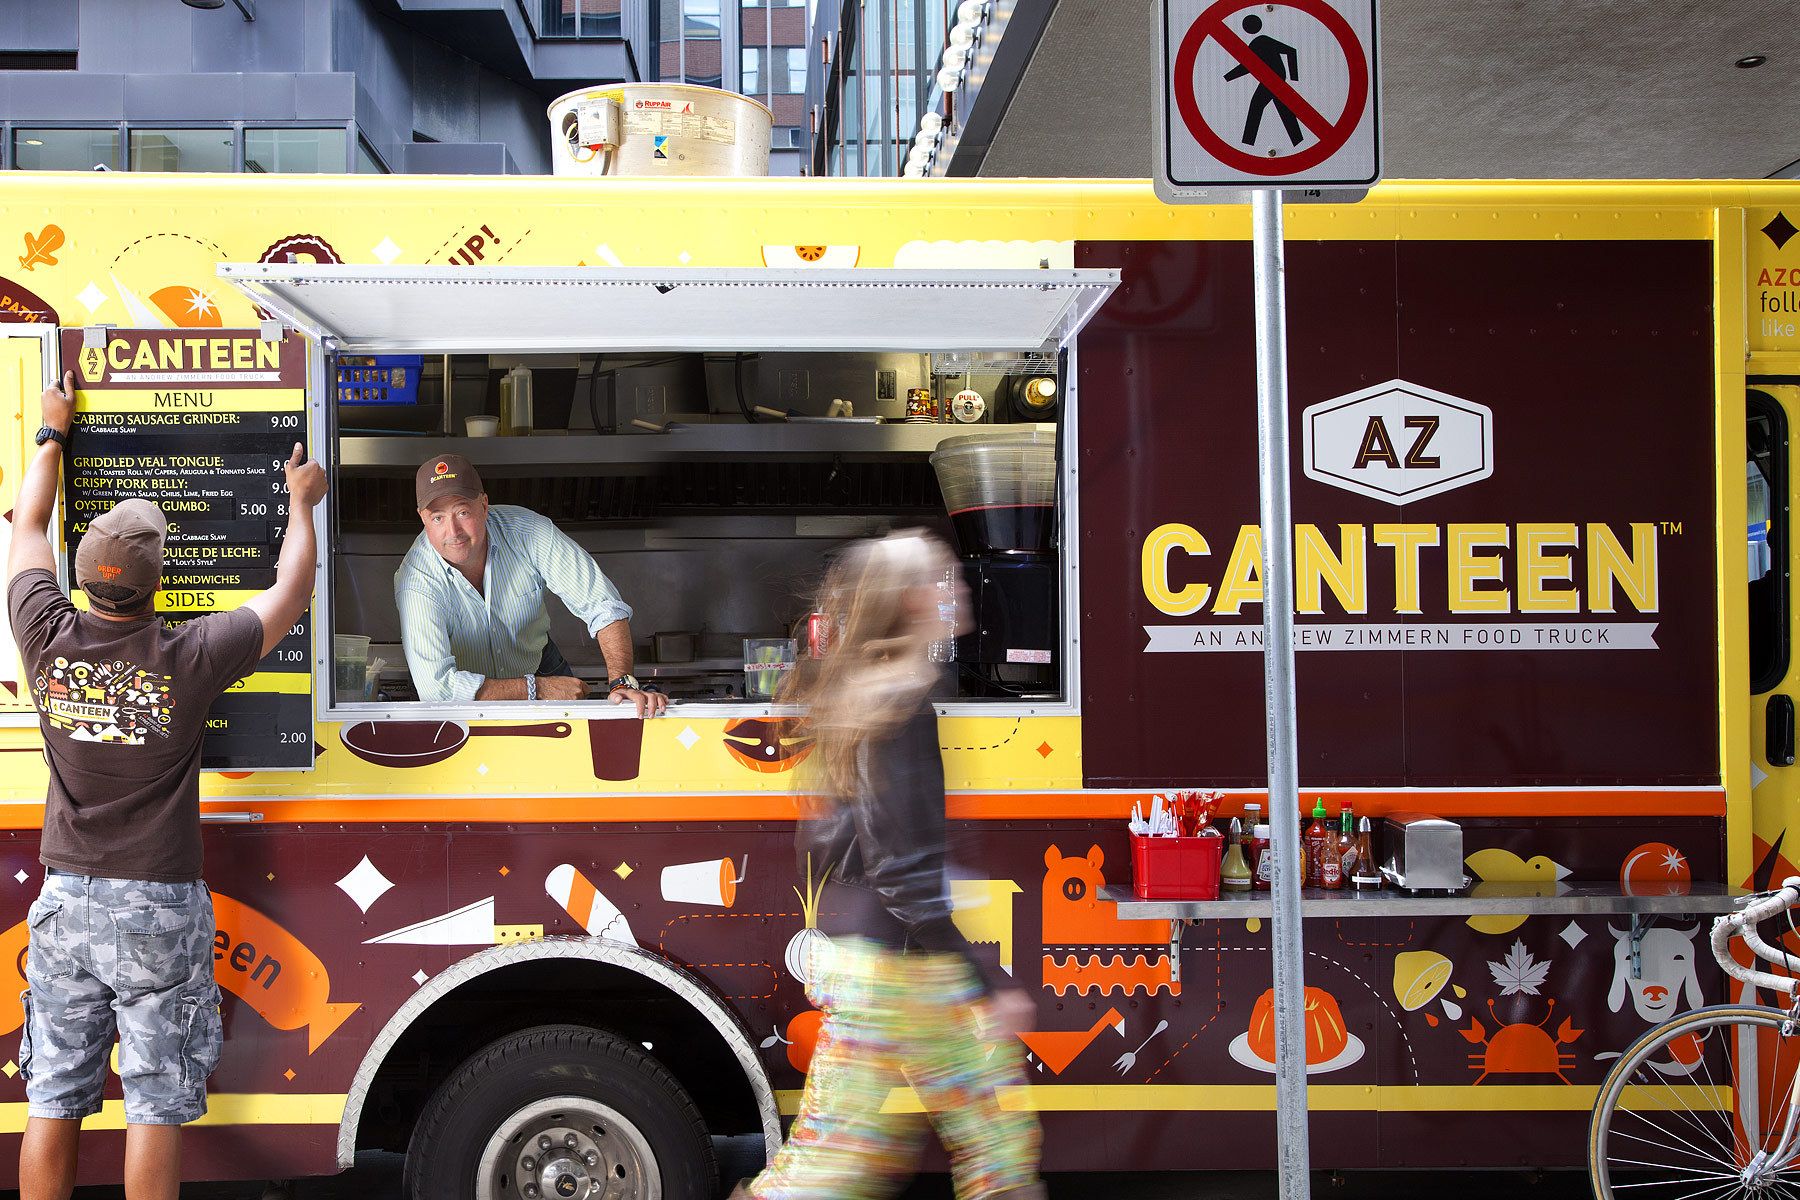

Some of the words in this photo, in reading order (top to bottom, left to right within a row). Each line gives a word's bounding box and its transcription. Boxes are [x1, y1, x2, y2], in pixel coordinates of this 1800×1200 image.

[1760, 291, 1800, 312] foll
[1762, 318, 1795, 336] like
[108, 338, 280, 370] CANTEEN
[154, 392, 213, 407] MENU
[73, 415, 124, 425] CABRITO
[127, 414, 180, 424] SAUSAGE
[183, 414, 240, 424] GRINDER:
[271, 416, 298, 427] 9.00
[1352, 416, 1440, 469] AZ
[74, 457, 134, 467] GRIDDLED
[137, 457, 167, 467] VEAL
[169, 457, 224, 467] TONGUE:
[272, 460, 290, 471] 9.0
[74, 478, 113, 488] CRISPY
[116, 478, 148, 488] PORK
[152, 479, 188, 488] BELLY:
[272, 483, 290, 493] 9.0
[162, 501, 210, 511] GUMBO:
[240, 504, 267, 515] 5.00
[202, 548, 218, 557] DE
[221, 548, 260, 557] LECHE:
[1142, 523, 1659, 616] CANTEEN
[173, 575, 240, 584] SANDWICHES
[165, 592, 215, 607] SIDES
[1193, 630, 1222, 646] AN
[1235, 630, 1332, 645] ANEW
[1345, 629, 1449, 644] ZIMMERN
[1463, 629, 1521, 644] FOOD
[1534, 629, 1610, 644] TRUCK
[278, 650, 303, 661] 1.00
[59, 702, 111, 717] CANTEEN
[280, 732, 306, 743] 2.00
